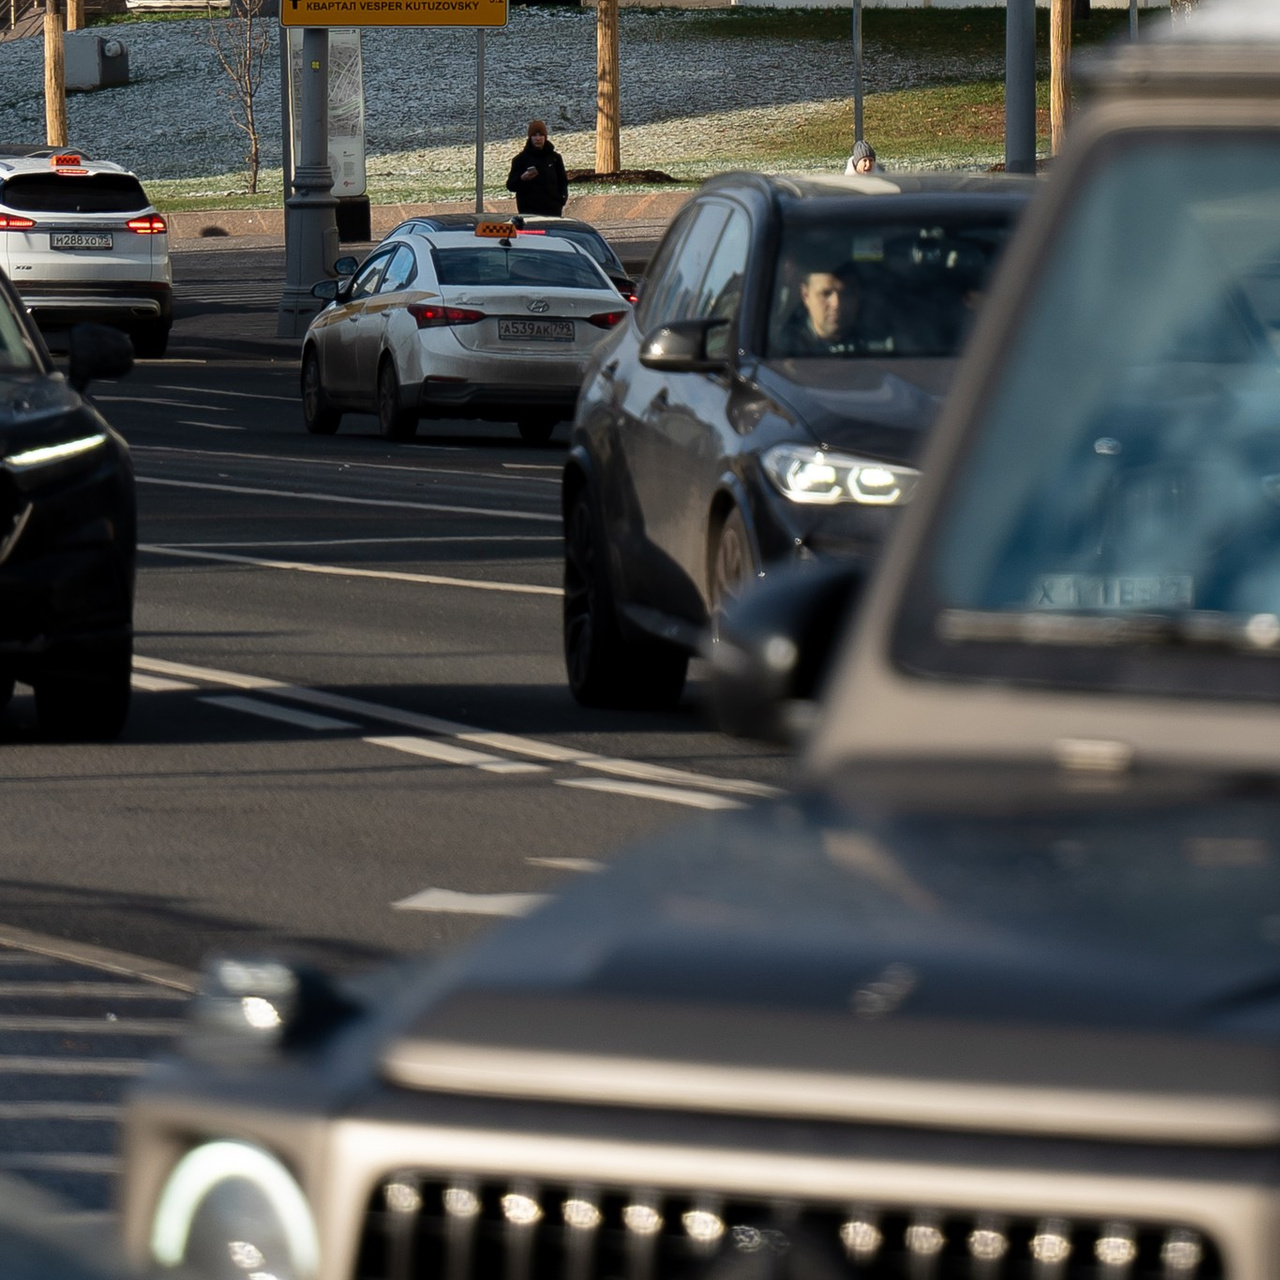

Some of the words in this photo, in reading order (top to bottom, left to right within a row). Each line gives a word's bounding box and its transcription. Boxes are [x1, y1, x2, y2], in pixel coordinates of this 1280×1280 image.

[306, 2, 356, 11] КВАРТАЛ
[359, 2, 403, 11] VESPER
[405, 1, 480, 11] KUTUZOVSKY
